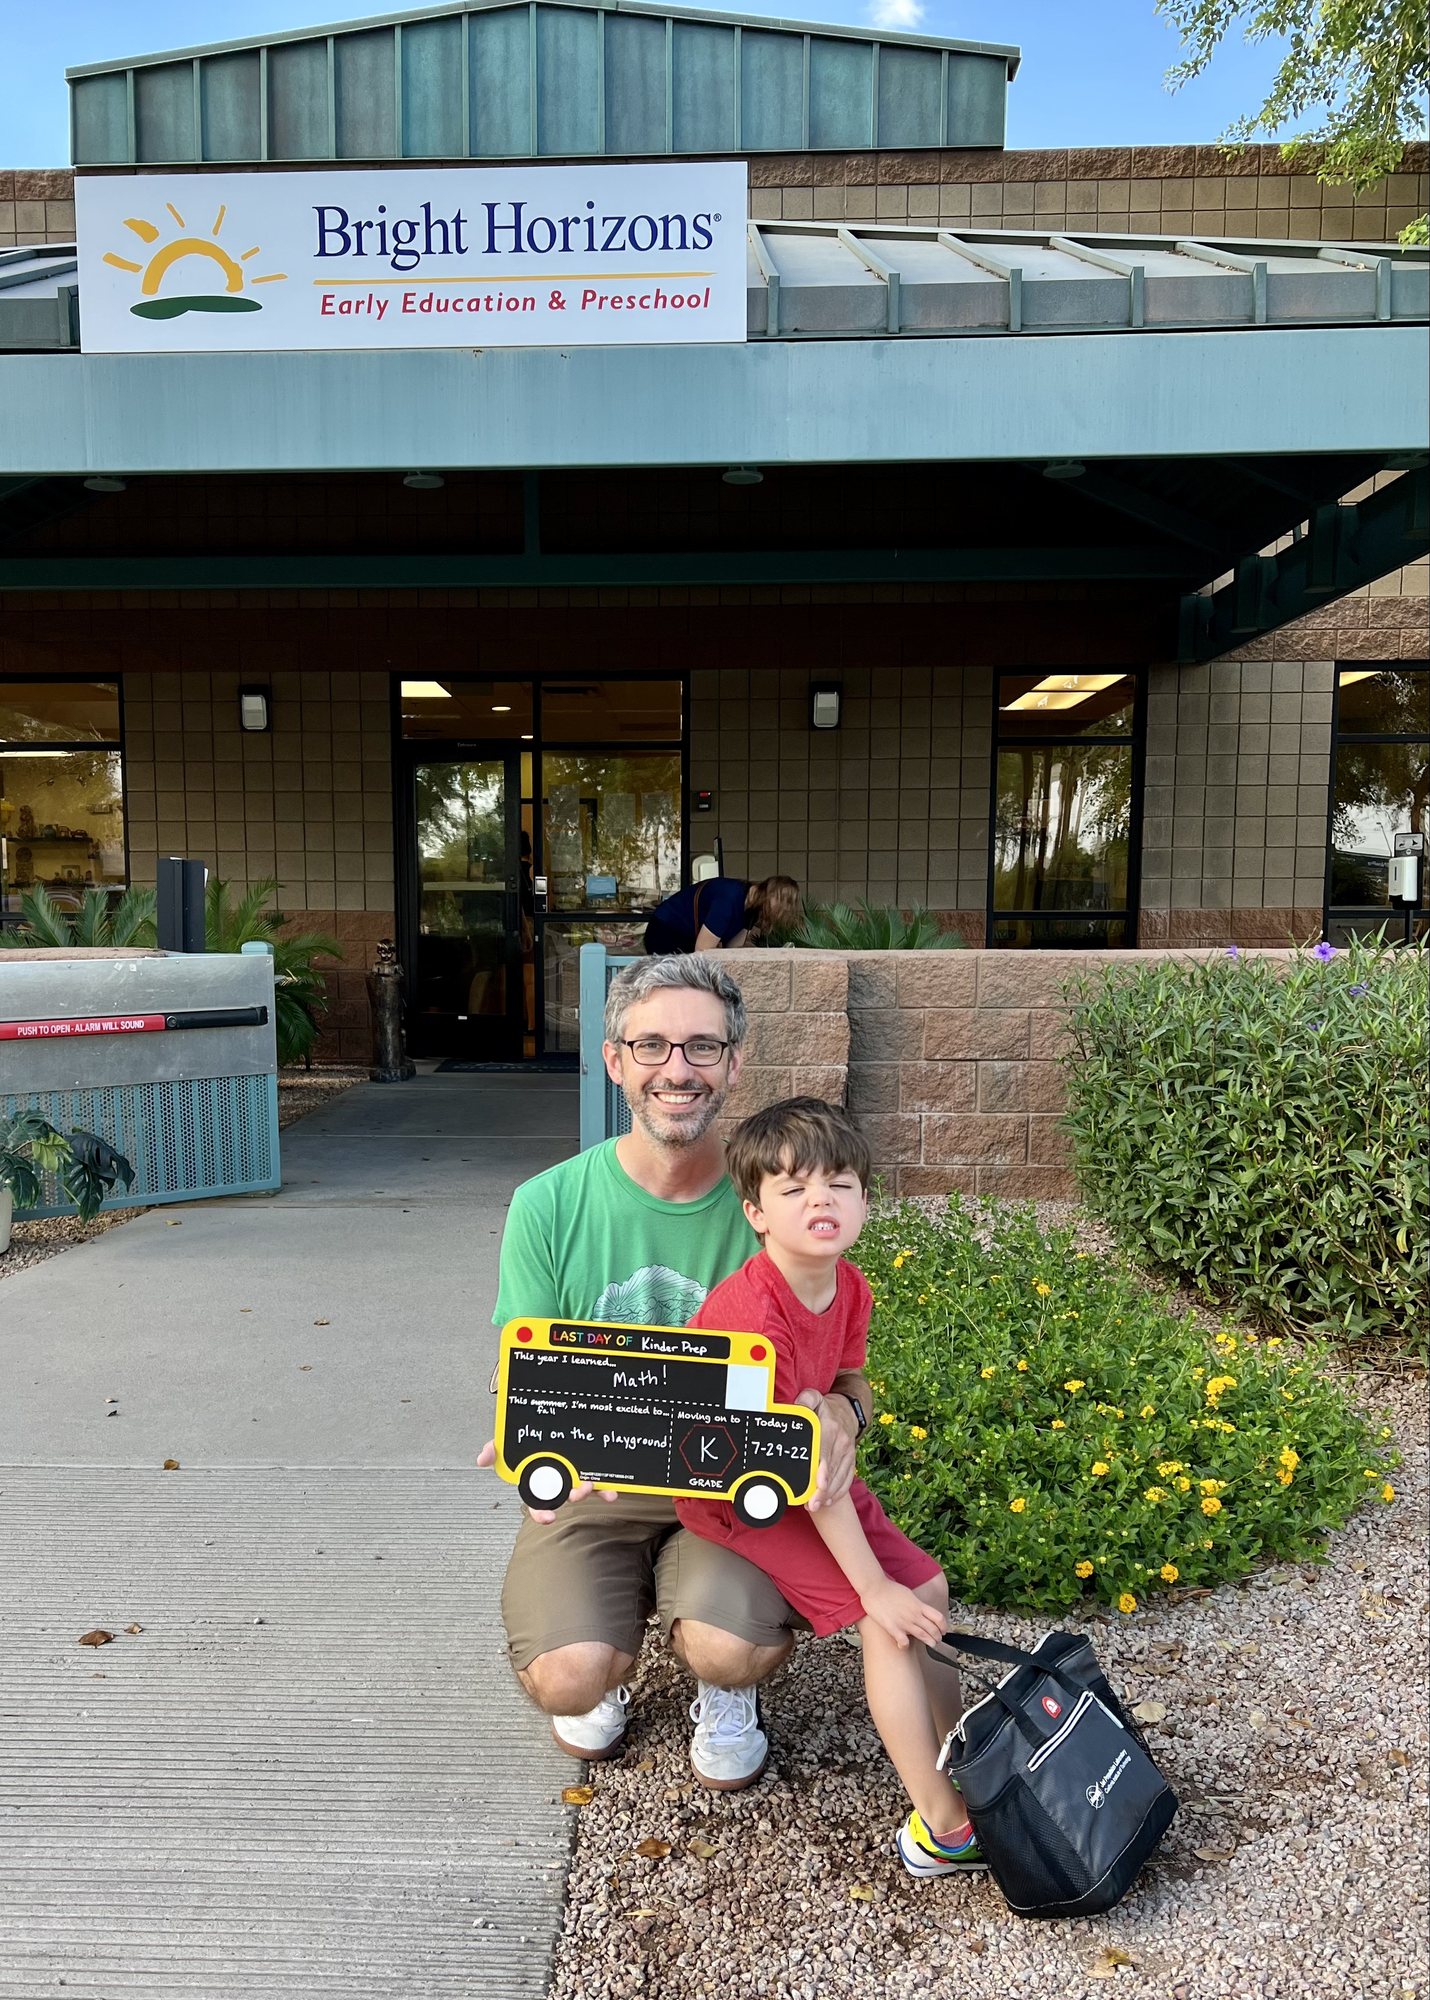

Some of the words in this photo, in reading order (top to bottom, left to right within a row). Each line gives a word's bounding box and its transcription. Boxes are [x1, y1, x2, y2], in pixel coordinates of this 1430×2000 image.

[312, 202, 469, 271] Bright
[321, 293, 389, 320] Early
[402, 292, 536, 314] Education
[548, 290, 567, 311] &
[581, 287, 711, 311] Preschool
[17, 1025, 38, 1036] PUSH
[39, 1025, 50, 1035] TO
[50, 1024, 71, 1034] OPEN
[74, 1022, 101, 1033] ALARM
[101, 1021, 120, 1031] WILL
[120, 1019, 145, 1030] SOUND
[553, 1330, 584, 1342] LAST
[587, 1332, 612, 1345] DAY
[616, 1334, 633, 1347] OF
[641, 1336, 679, 1353] Kinder
[681, 1340, 708, 1356] Prep
[513, 1351, 534, 1361] This
[537, 1354, 559, 1366] year
[561, 1355, 568, 1363] I
[508, 1395, 528, 1405] This
[571, 1400, 587, 1410] I'm
[590, 1402, 613, 1412] most
[615, 1404, 650, 1415] excited
[536, 1405, 556, 1415] fall
[677, 1411, 711, 1424] Moving
[714, 1415, 728, 1424] on
[730, 1414, 741, 1424] to
[754, 1417, 788, 1433] Today
[791, 1420, 804, 1430] is:
[517, 1424, 543, 1443] play
[550, 1430, 565, 1440] on
[570, 1426, 595, 1442] the
[603, 1430, 668, 1450] playground
[701, 1435, 719, 1463] K
[751, 1441, 809, 1461] 7-29-22
[688, 1477, 723, 1488] GRADE
